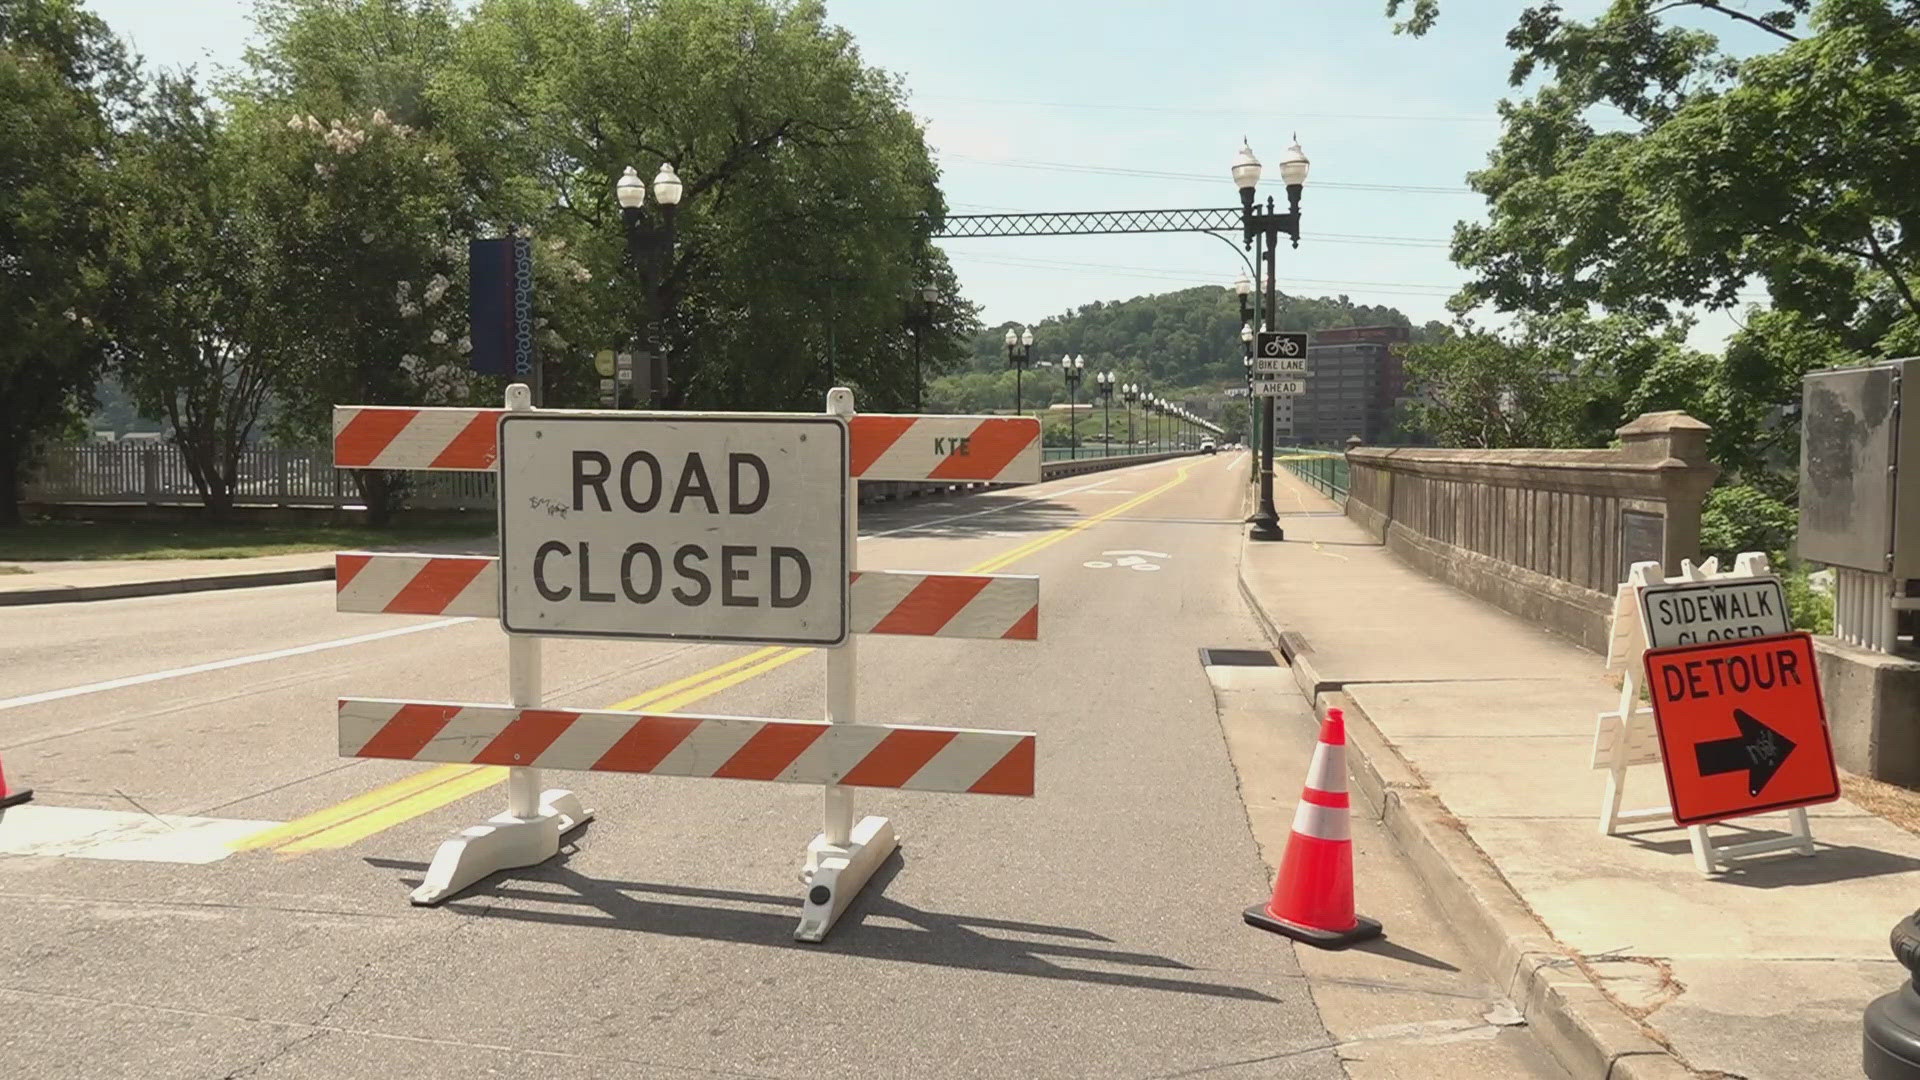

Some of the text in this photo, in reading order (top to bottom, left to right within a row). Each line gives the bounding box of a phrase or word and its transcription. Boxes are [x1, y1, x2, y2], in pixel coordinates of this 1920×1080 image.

[1258, 359, 1304, 370] BIKE LANE
[1263, 383, 1297, 393] AHEAD
[934, 437, 971, 456] KTE
[572, 450, 770, 515] ROAD
[533, 540, 812, 608] CLOSED
[1659, 590, 1773, 626] SIDEWALK
[1662, 650, 1802, 702] DETOUR
